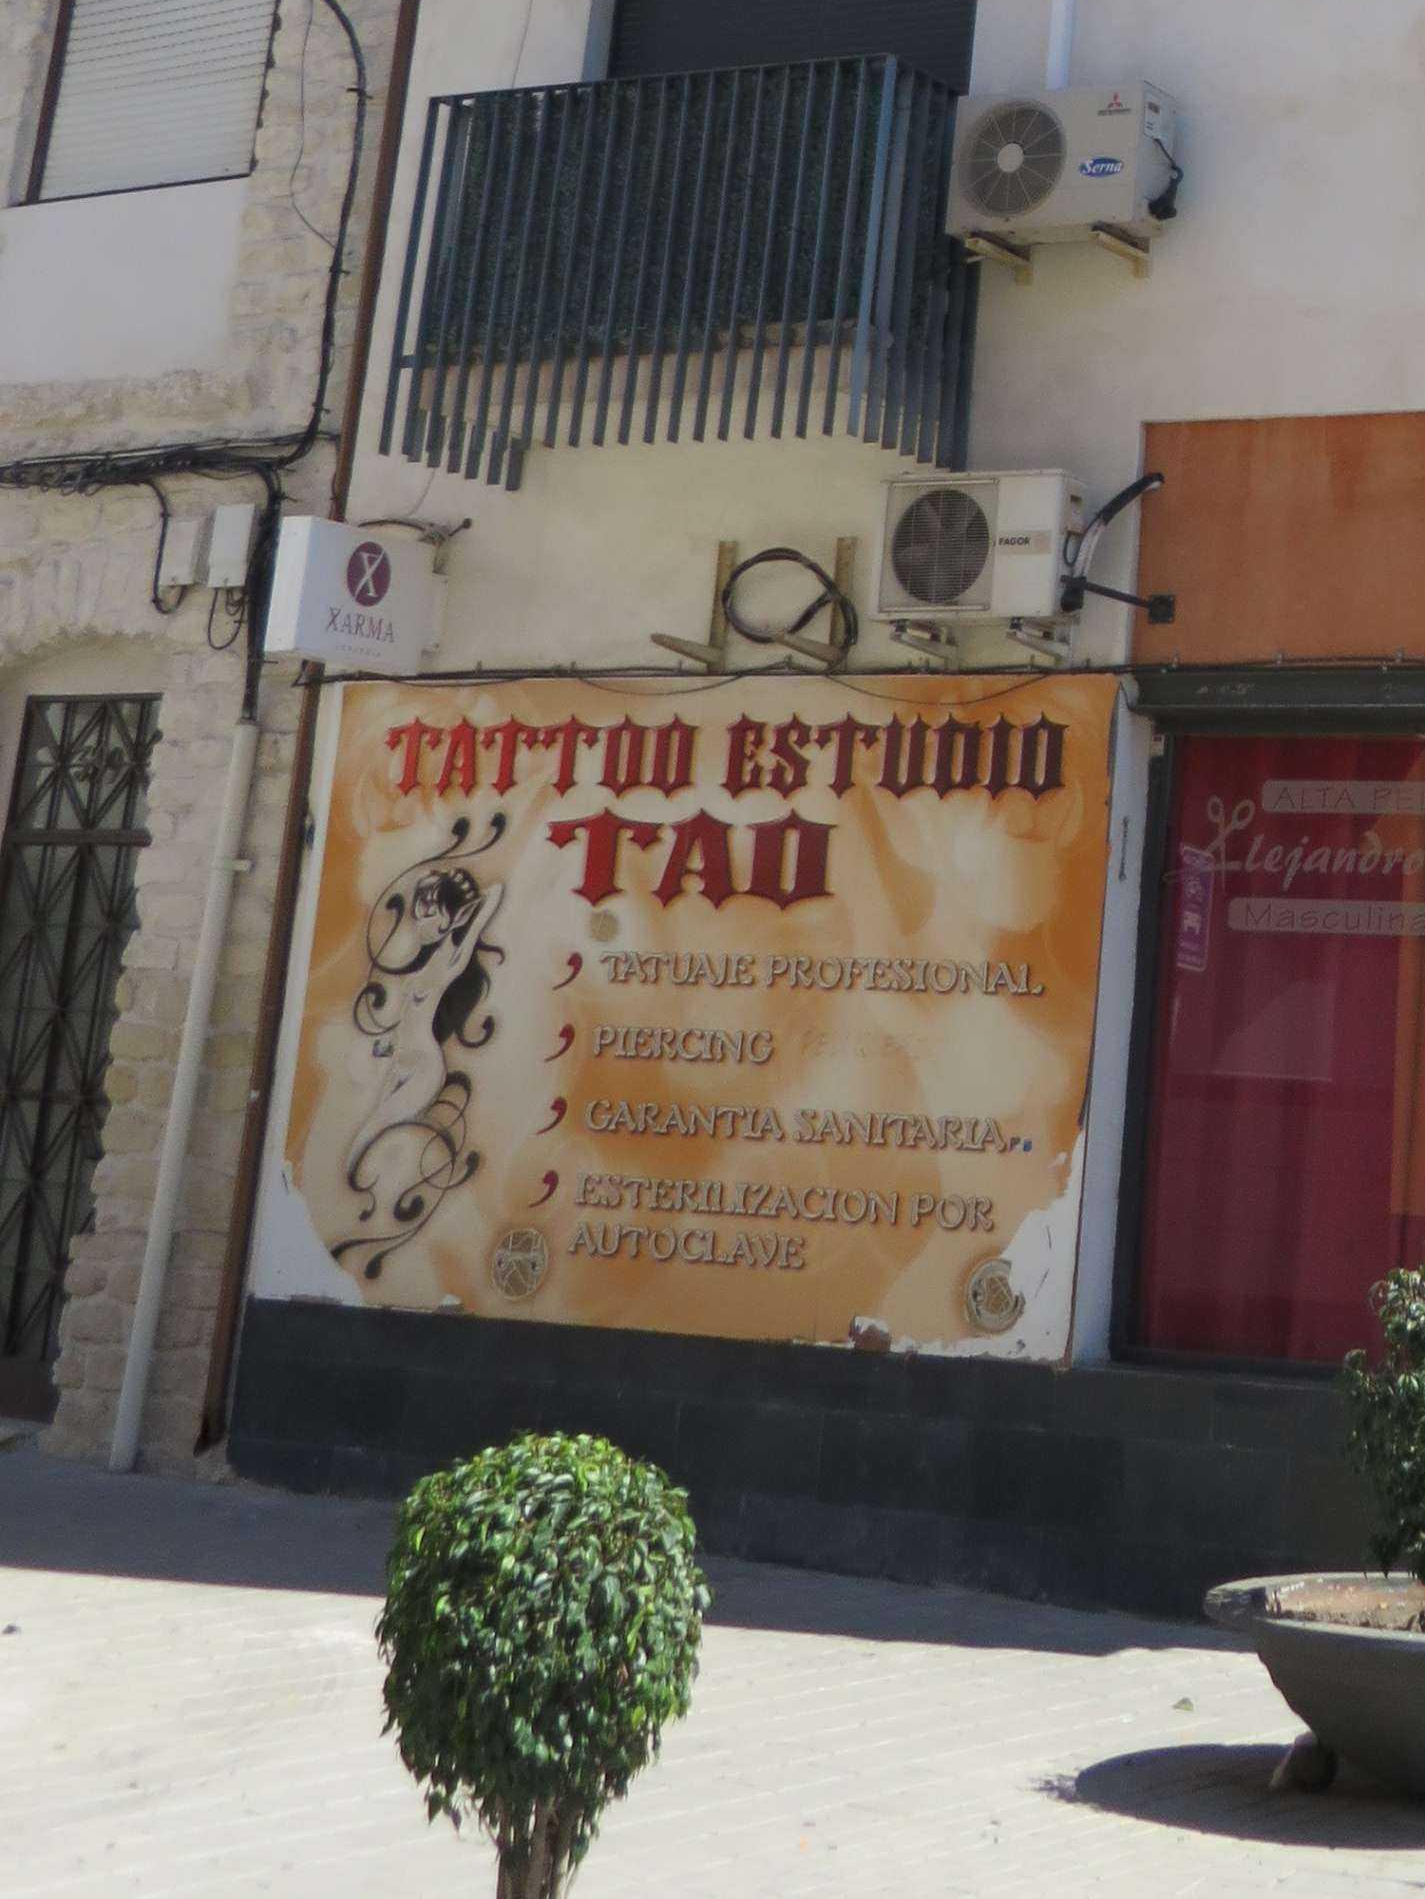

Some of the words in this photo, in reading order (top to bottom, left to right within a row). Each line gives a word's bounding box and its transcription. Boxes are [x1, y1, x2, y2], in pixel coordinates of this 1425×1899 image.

[1081, 158, 1122, 175] Serna
[327, 607, 395, 642] XARMA
[385, 713, 698, 798] TATTOO
[720, 711, 1069, 800] ESTUDIO
[1273, 786, 1355, 811] ALTA
[546, 806, 838, 911] TAO
[601, 950, 755, 988] TATUAJE
[766, 954, 1046, 996] PROFESIONAL
[592, 1025, 776, 1064] PIERCING
[585, 1100, 784, 1142] GARANTIA
[573, 1172, 899, 1225] ESTERILIZACION
[911, 1193, 995, 1232] POR
[568, 1222, 807, 1271] AUTOCLAVE
